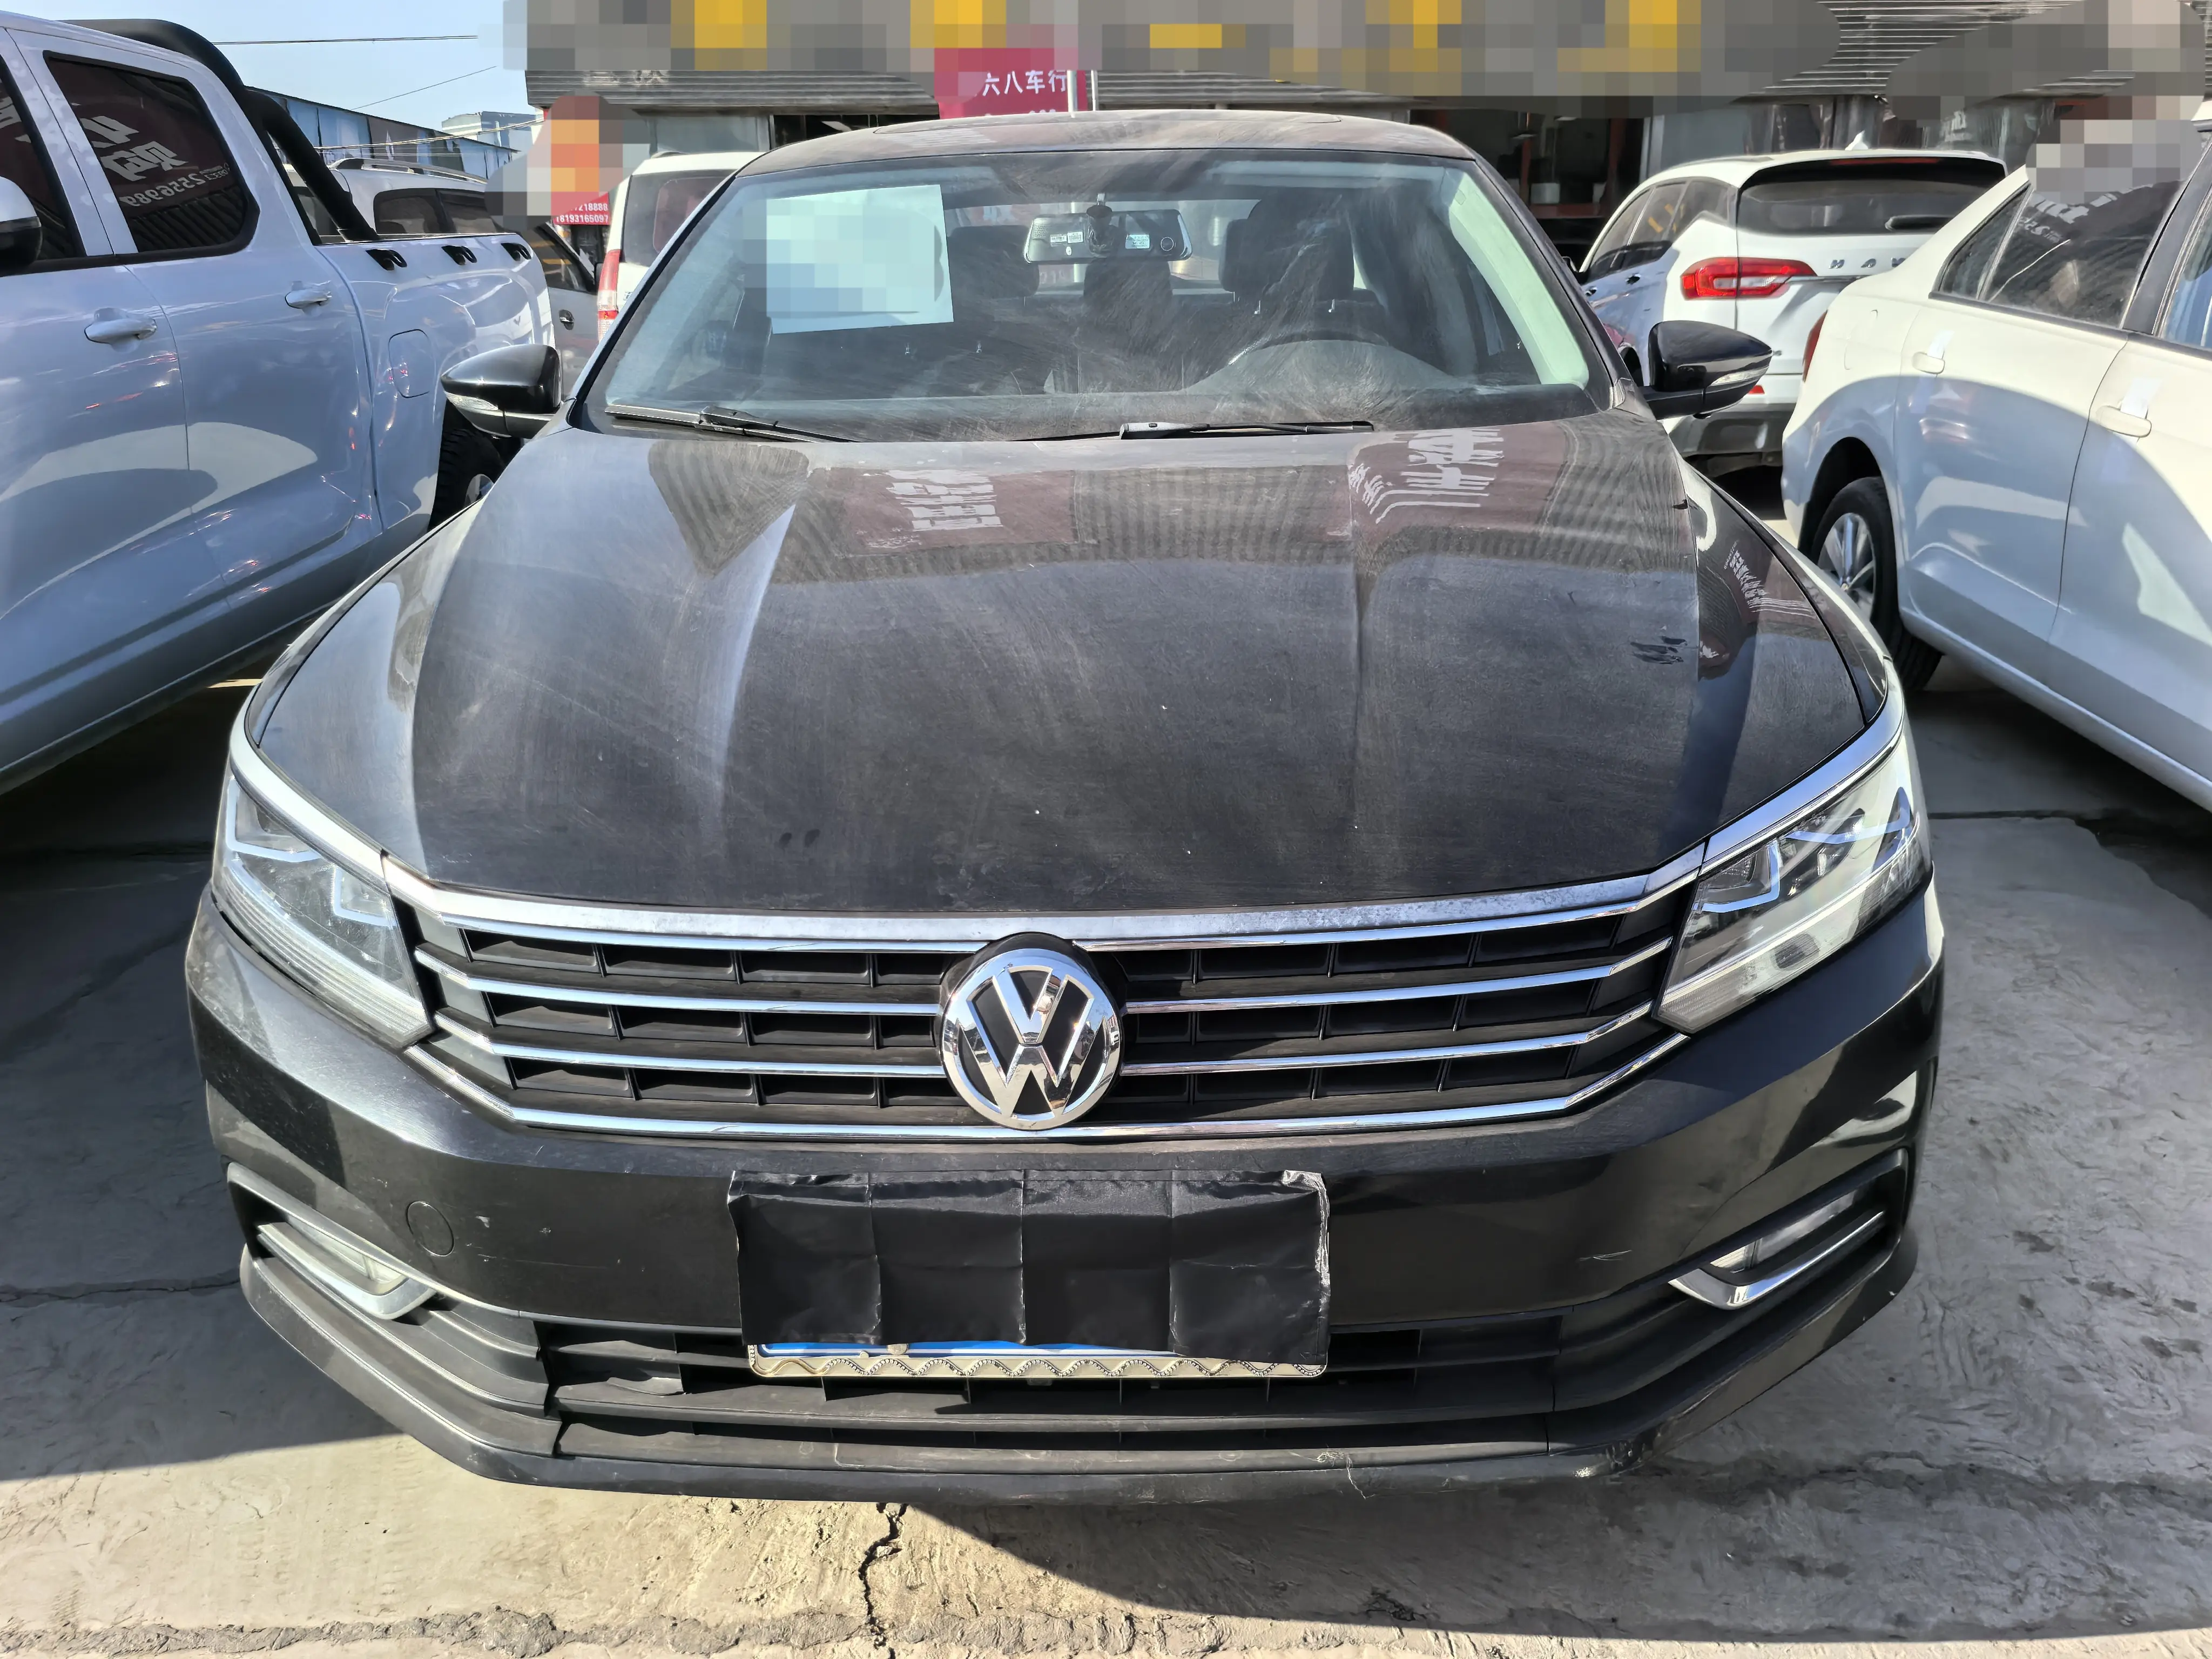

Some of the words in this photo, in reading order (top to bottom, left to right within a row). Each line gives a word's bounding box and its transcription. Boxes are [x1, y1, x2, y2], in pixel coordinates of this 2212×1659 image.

[982, 70, 1067, 96] 六八车行
[571, 203, 608, 211] 218888
[556, 214, 609, 223] 18193165097
